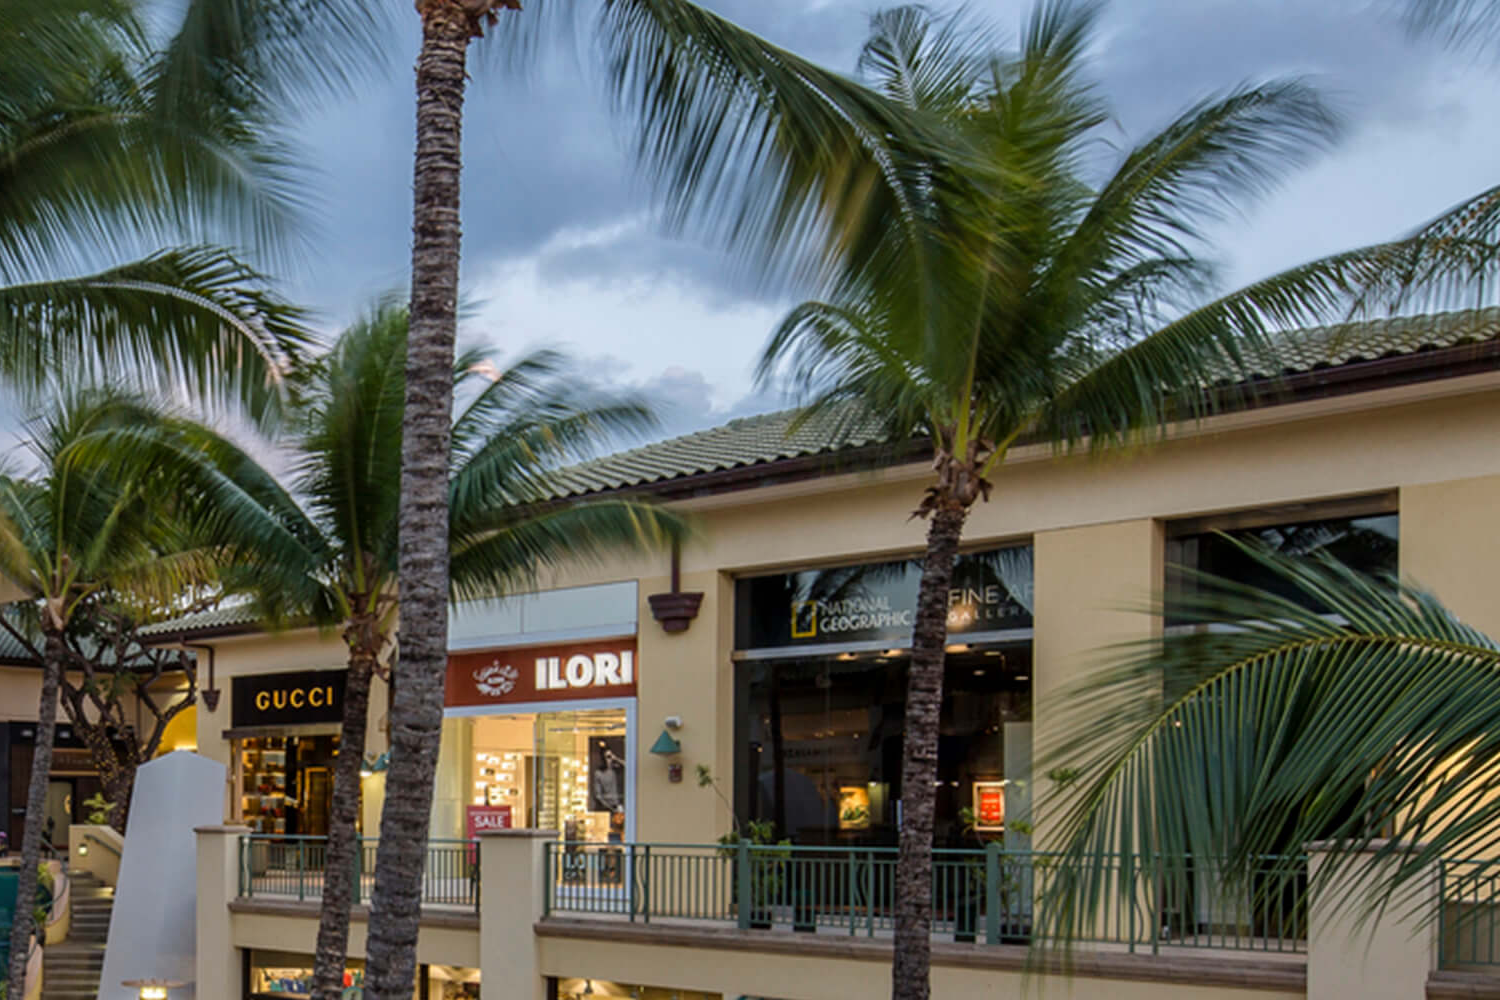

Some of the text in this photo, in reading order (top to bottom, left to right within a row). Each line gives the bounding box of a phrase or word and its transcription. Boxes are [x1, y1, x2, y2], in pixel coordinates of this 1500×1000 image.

[818, 596, 893, 617] NATIONAL
[947, 585, 1000, 607] FINE
[820, 609, 911, 633] GEOGRAPHIC
[535, 650, 633, 691] ILORI
[255, 686, 333, 711] GUCCI
[474, 815, 505, 829] SALE
